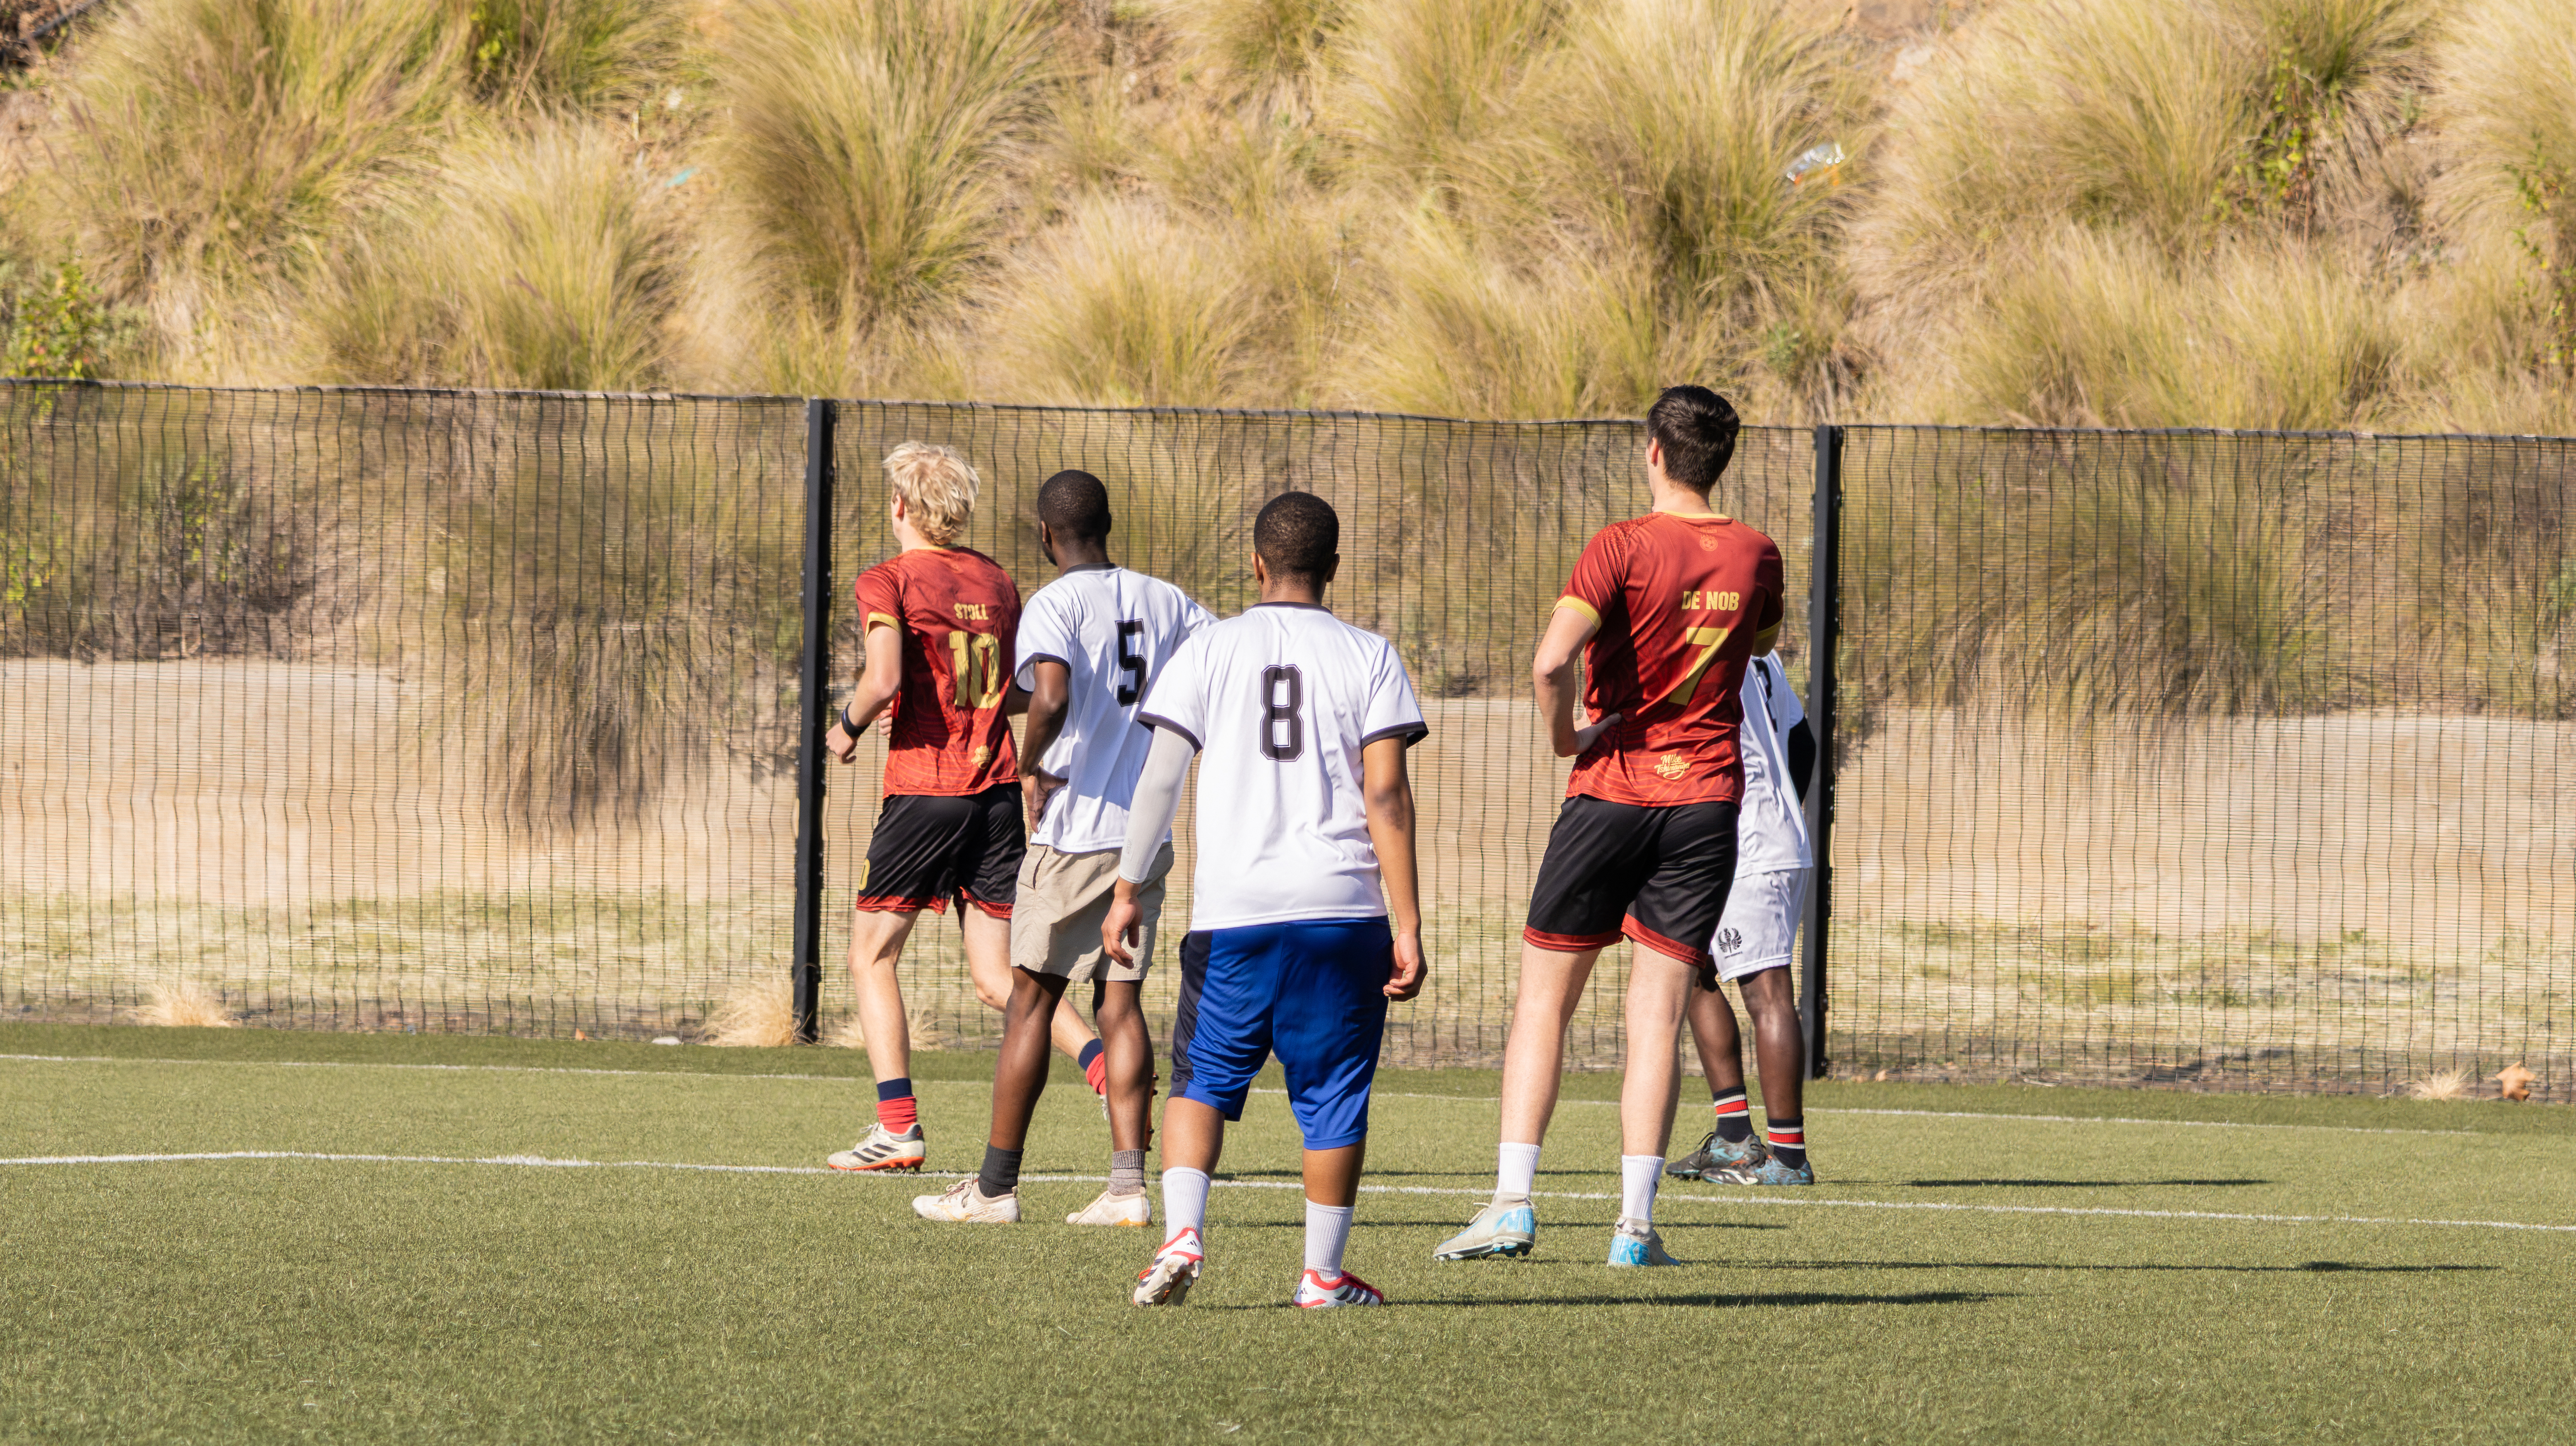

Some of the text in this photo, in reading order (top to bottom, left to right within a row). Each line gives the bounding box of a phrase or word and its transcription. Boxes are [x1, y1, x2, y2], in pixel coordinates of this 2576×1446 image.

[954, 602, 989, 620] STOLL
[1681, 591, 1740, 611] DE NOB
[949, 630, 1000, 709] 10
[1115, 618, 1149, 708] 5
[1668, 627, 1728, 706] 7
[1260, 664, 1304, 762] 8
[1654, 762, 1690, 780] Tshimanga
[1660, 753, 1682, 765] Mike
[1608, 1236, 1652, 1266] IKE
